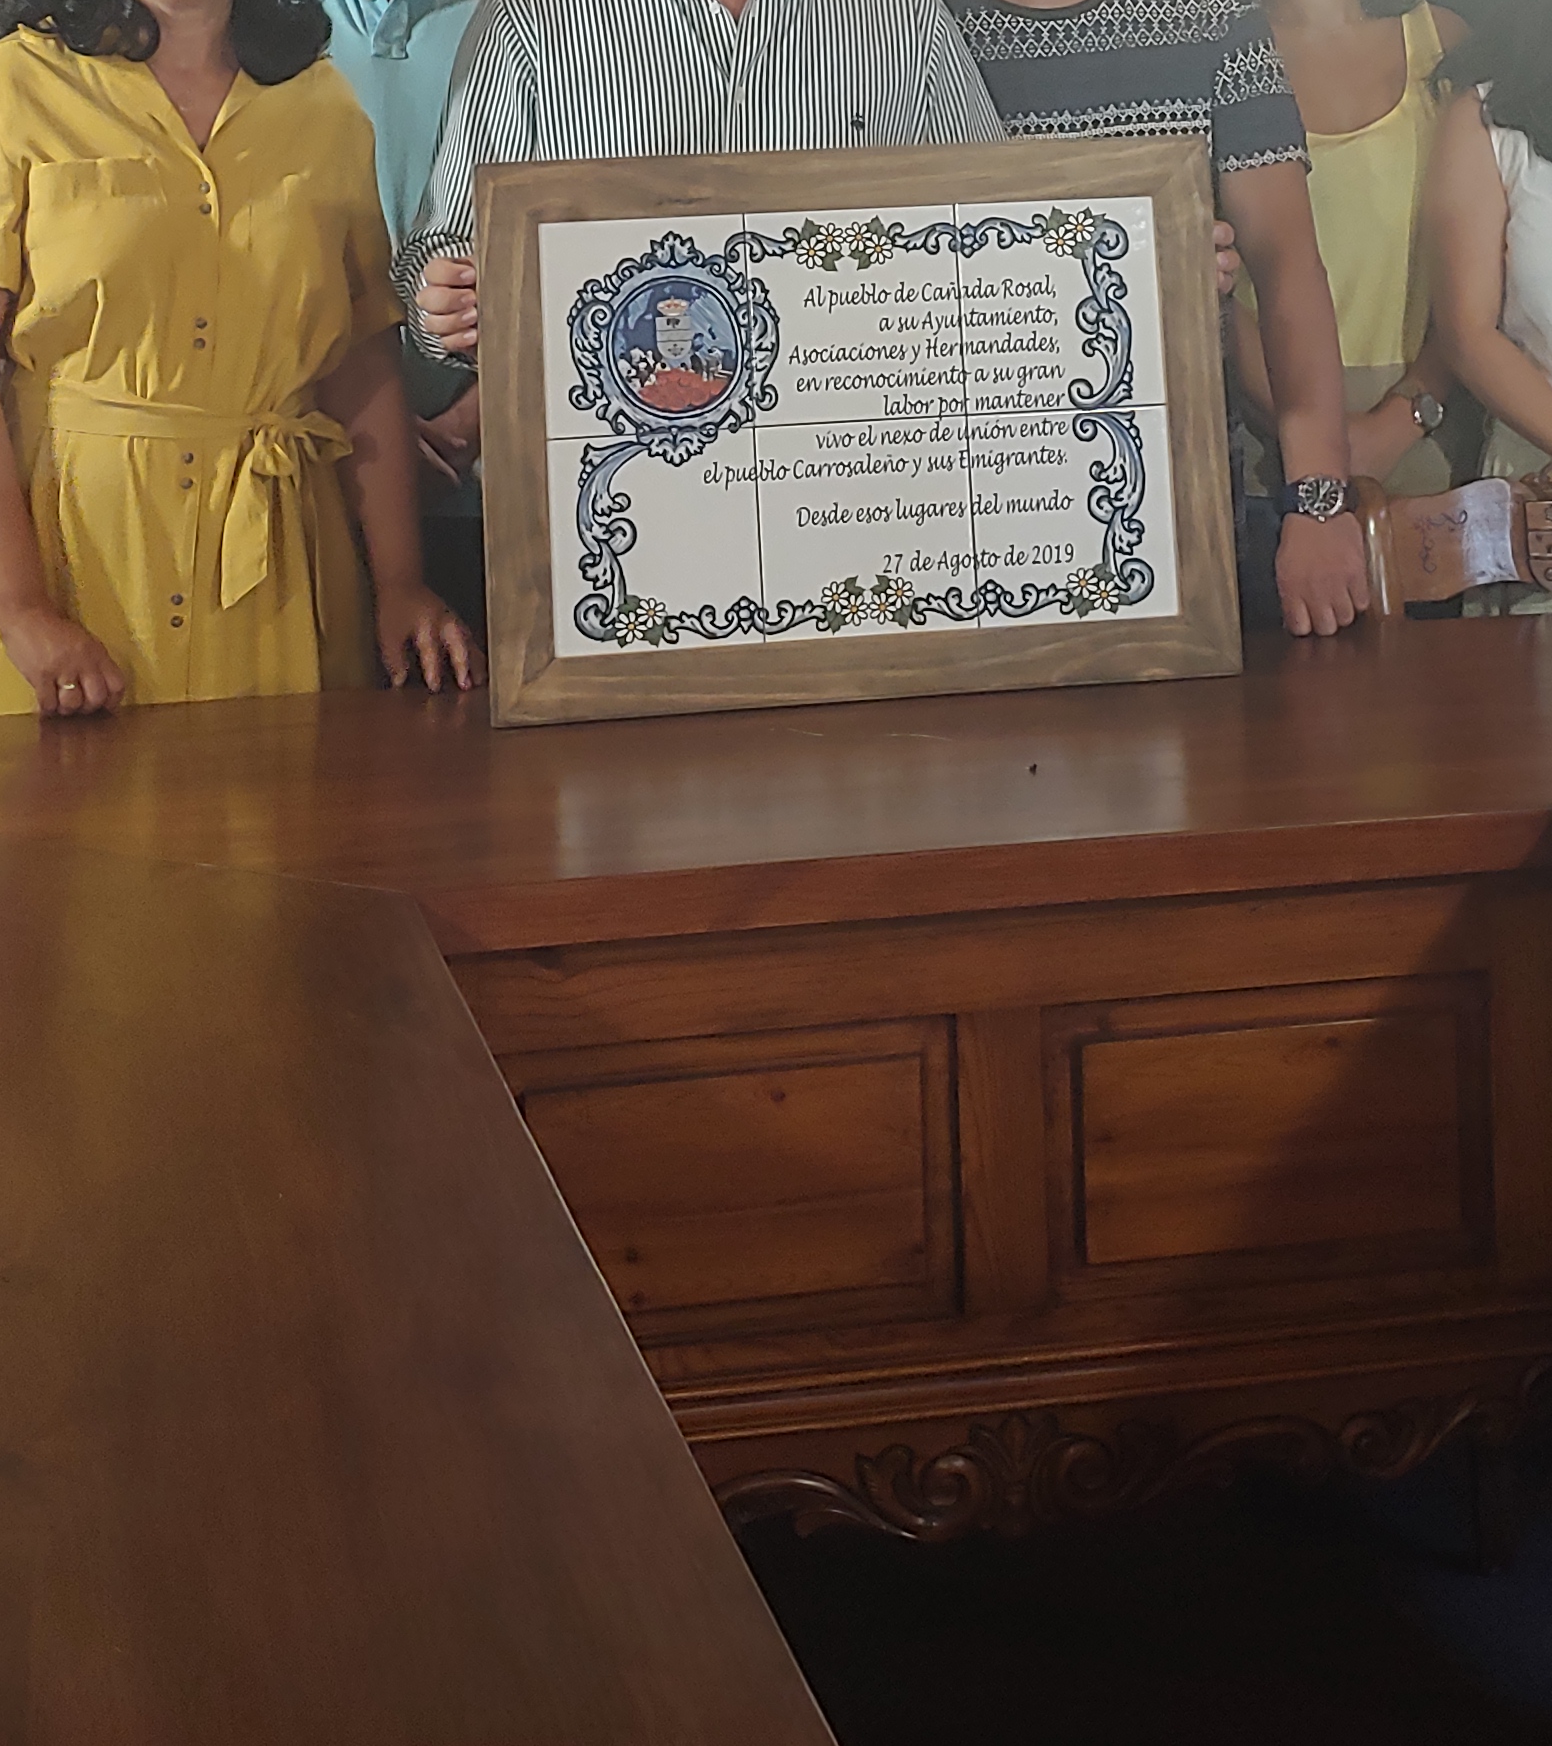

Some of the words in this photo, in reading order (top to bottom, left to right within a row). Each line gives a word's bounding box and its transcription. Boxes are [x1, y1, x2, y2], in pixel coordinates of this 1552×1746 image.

[803, 285, 826, 309] Al
[828, 282, 892, 314] pueblo
[894, 281, 919, 304] de
[921, 278, 999, 303] Cañada
[1001, 275, 1057, 300] Rosal,
[878, 315, 894, 332] a
[897, 314, 921, 333] su
[921, 305, 1059, 336] Ayuntamiento,
[788, 342, 908, 366] Asociaciones
[908, 343, 922, 365] y
[924, 331, 1061, 360] Hermandades,
[796, 375, 823, 393] en
[824, 366, 971, 392] reconocimiento
[974, 367, 990, 383] a
[992, 365, 1016, 384] su
[1017, 363, 1066, 389] gran
[883, 394, 935, 417] labor
[937, 396, 970, 421] por
[974, 390, 1067, 411] mantener
[815, 429, 855, 450] vivo
[857, 425, 878, 447] el
[879, 426, 926, 445] nexo
[929, 420, 955, 443] de
[956, 418, 1018, 441] unión
[1019, 417, 1070, 438] entre
[703, 462, 723, 485] el
[724, 459, 791, 491] pueblo
[792, 451, 910, 480] Carrosaleño
[910, 457, 923, 478] y
[926, 453, 956, 472] sus
[958, 445, 1069, 476] Emigrantes.
[796, 502, 853, 528] Desde
[855, 505, 894, 525] esos
[895, 498, 968, 527] lugares
[970, 492, 1003, 517] del
[1005, 489, 1076, 514] mundo
[882, 554, 905, 574] 27
[909, 550, 936, 572] de
[936, 547, 1002, 577] Agosto
[1003, 545, 1030, 568] de
[1031, 543, 1076, 566] 2019
